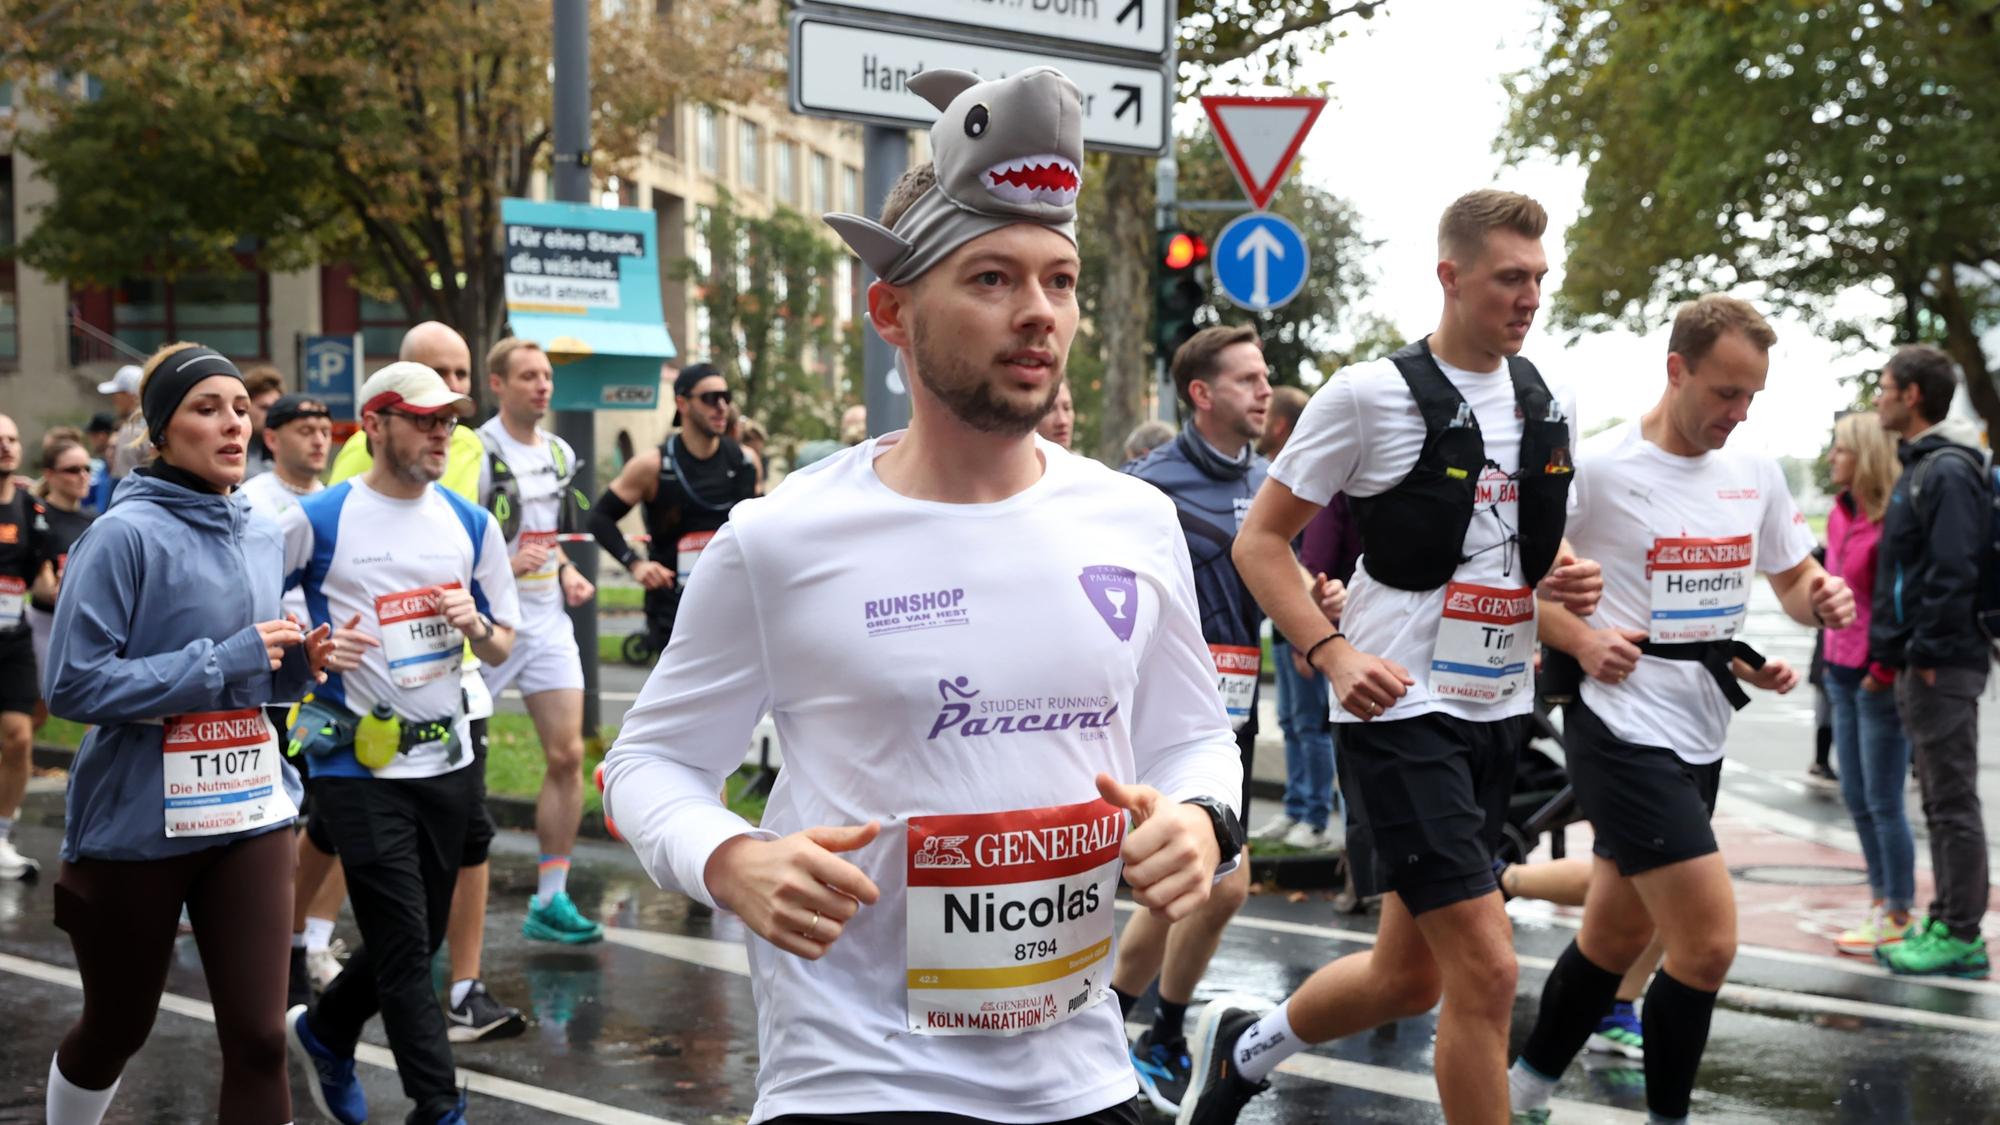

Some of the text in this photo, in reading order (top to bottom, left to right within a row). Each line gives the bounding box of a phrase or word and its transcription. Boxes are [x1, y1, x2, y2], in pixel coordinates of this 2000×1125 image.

[508, 226, 643, 257] Für eine Stadt,
[510, 252, 617, 279] die wächst.
[320, 352, 345, 387] P
[1667, 572, 1744, 593] Hendrik
[865, 588, 965, 619] RUNSHOP
[866, 617, 900, 629] GREG
[905, 612, 931, 622] VAN
[936, 608, 968, 618] HEST
[980, 696, 1108, 714] STUDENT RUNNING
[928, 702, 1119, 740] Parcival
[190, 748, 261, 777] T1077
[170, 783, 192, 795] Die
[974, 811, 1122, 868] GENERALI
[944, 882, 1100, 934] Nicolas
[1014, 938, 1057, 961] 8794
[919, 974, 939, 985] 42.2
[996, 995, 1042, 1012] GENERALI
[927, 1007, 1041, 1030] KÖLN MARATHON
